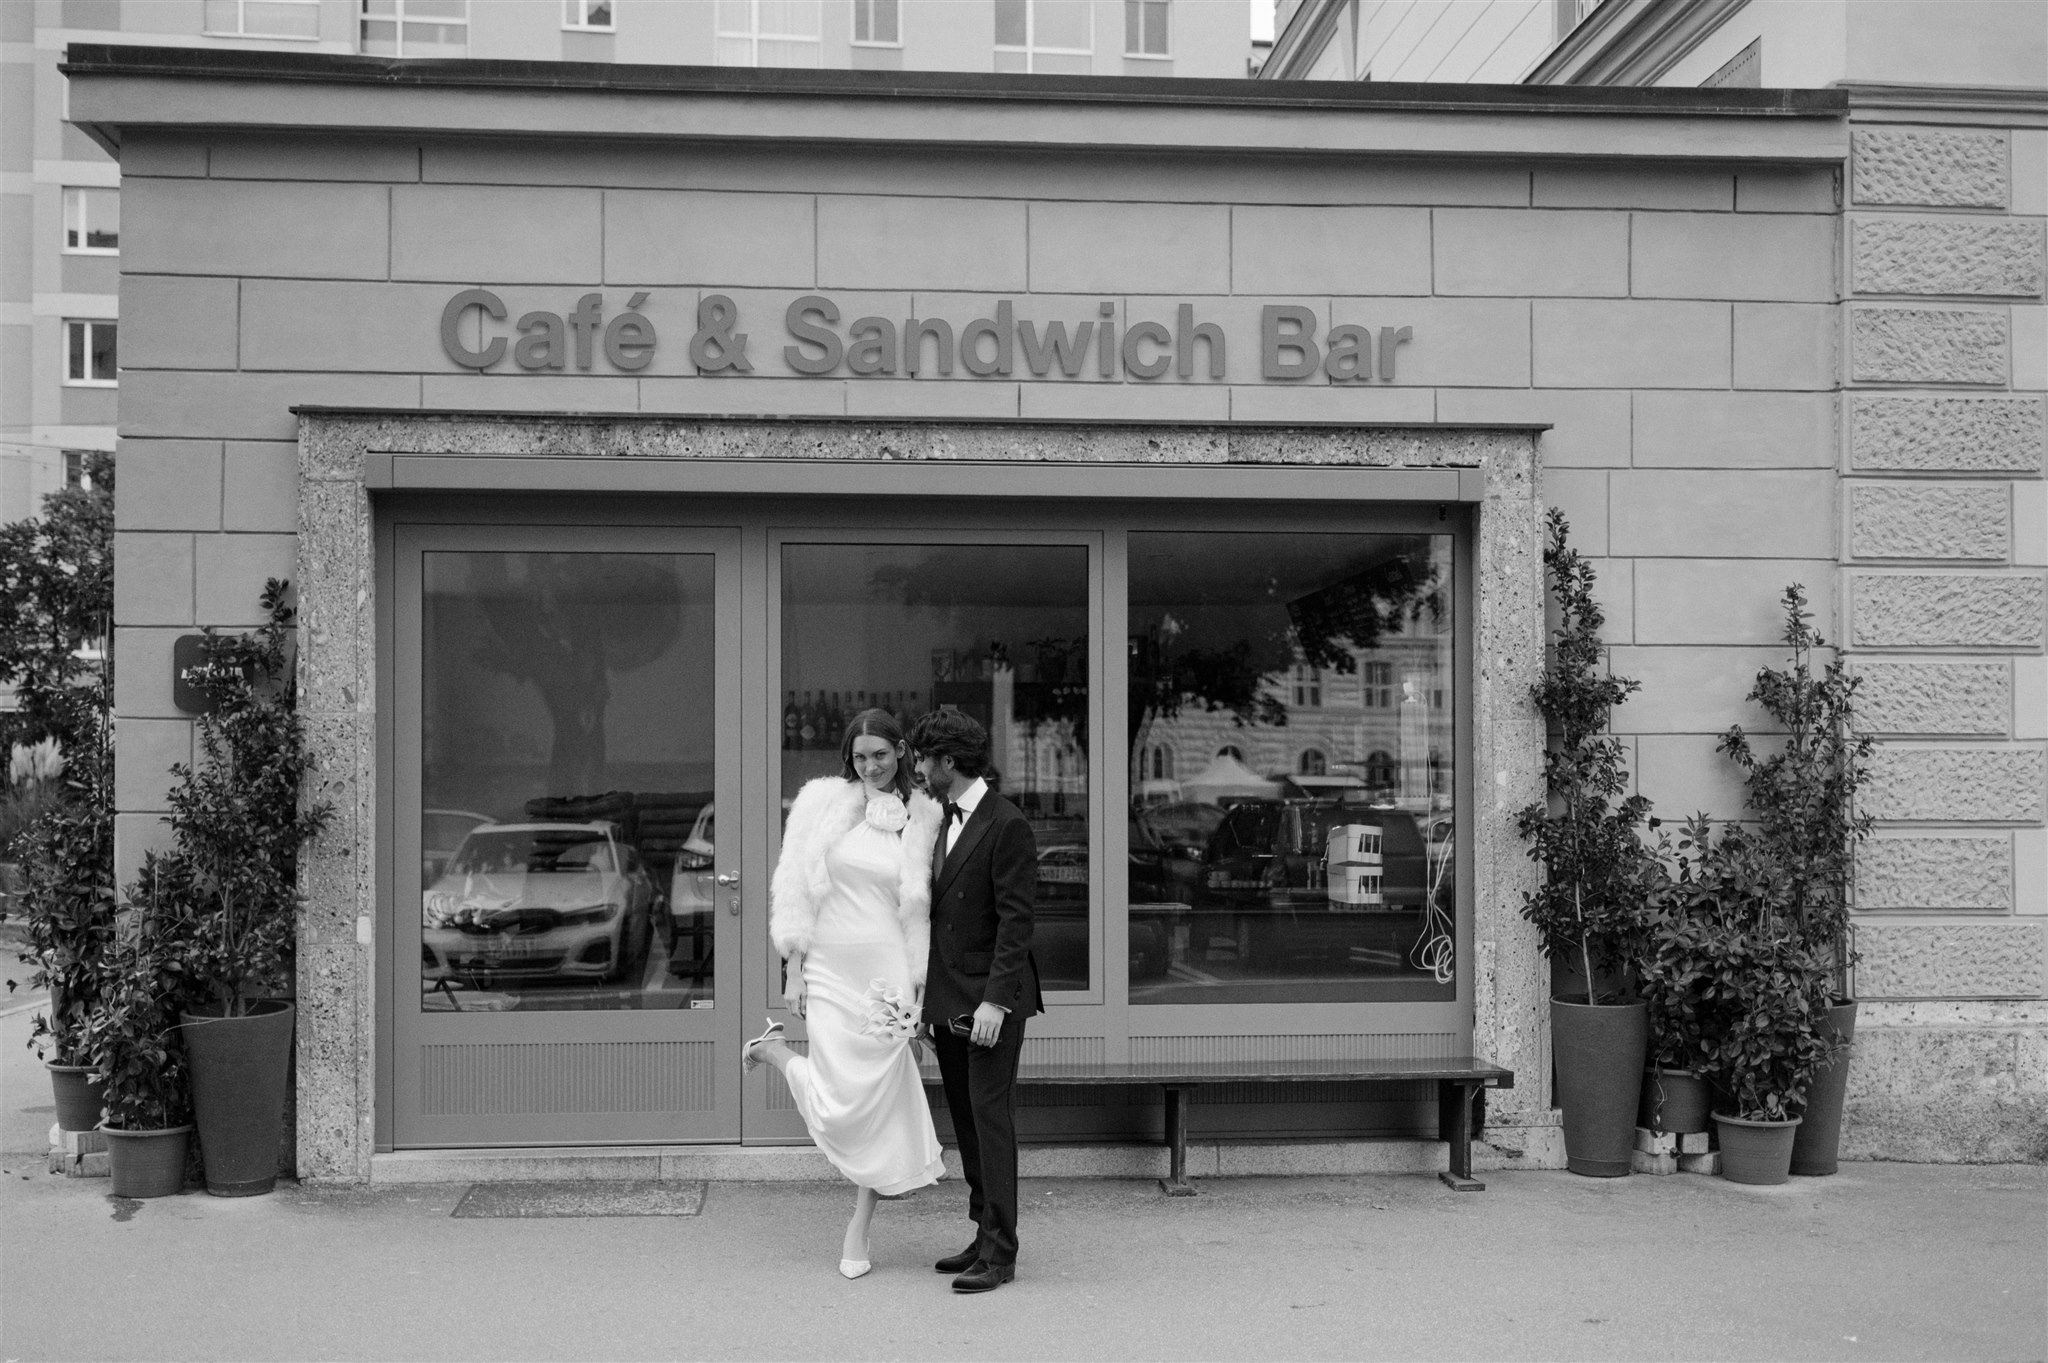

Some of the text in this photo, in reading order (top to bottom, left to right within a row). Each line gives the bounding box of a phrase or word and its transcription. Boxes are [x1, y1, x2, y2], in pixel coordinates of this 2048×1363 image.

[441, 288, 1413, 382] Café & Sandwich Bar
